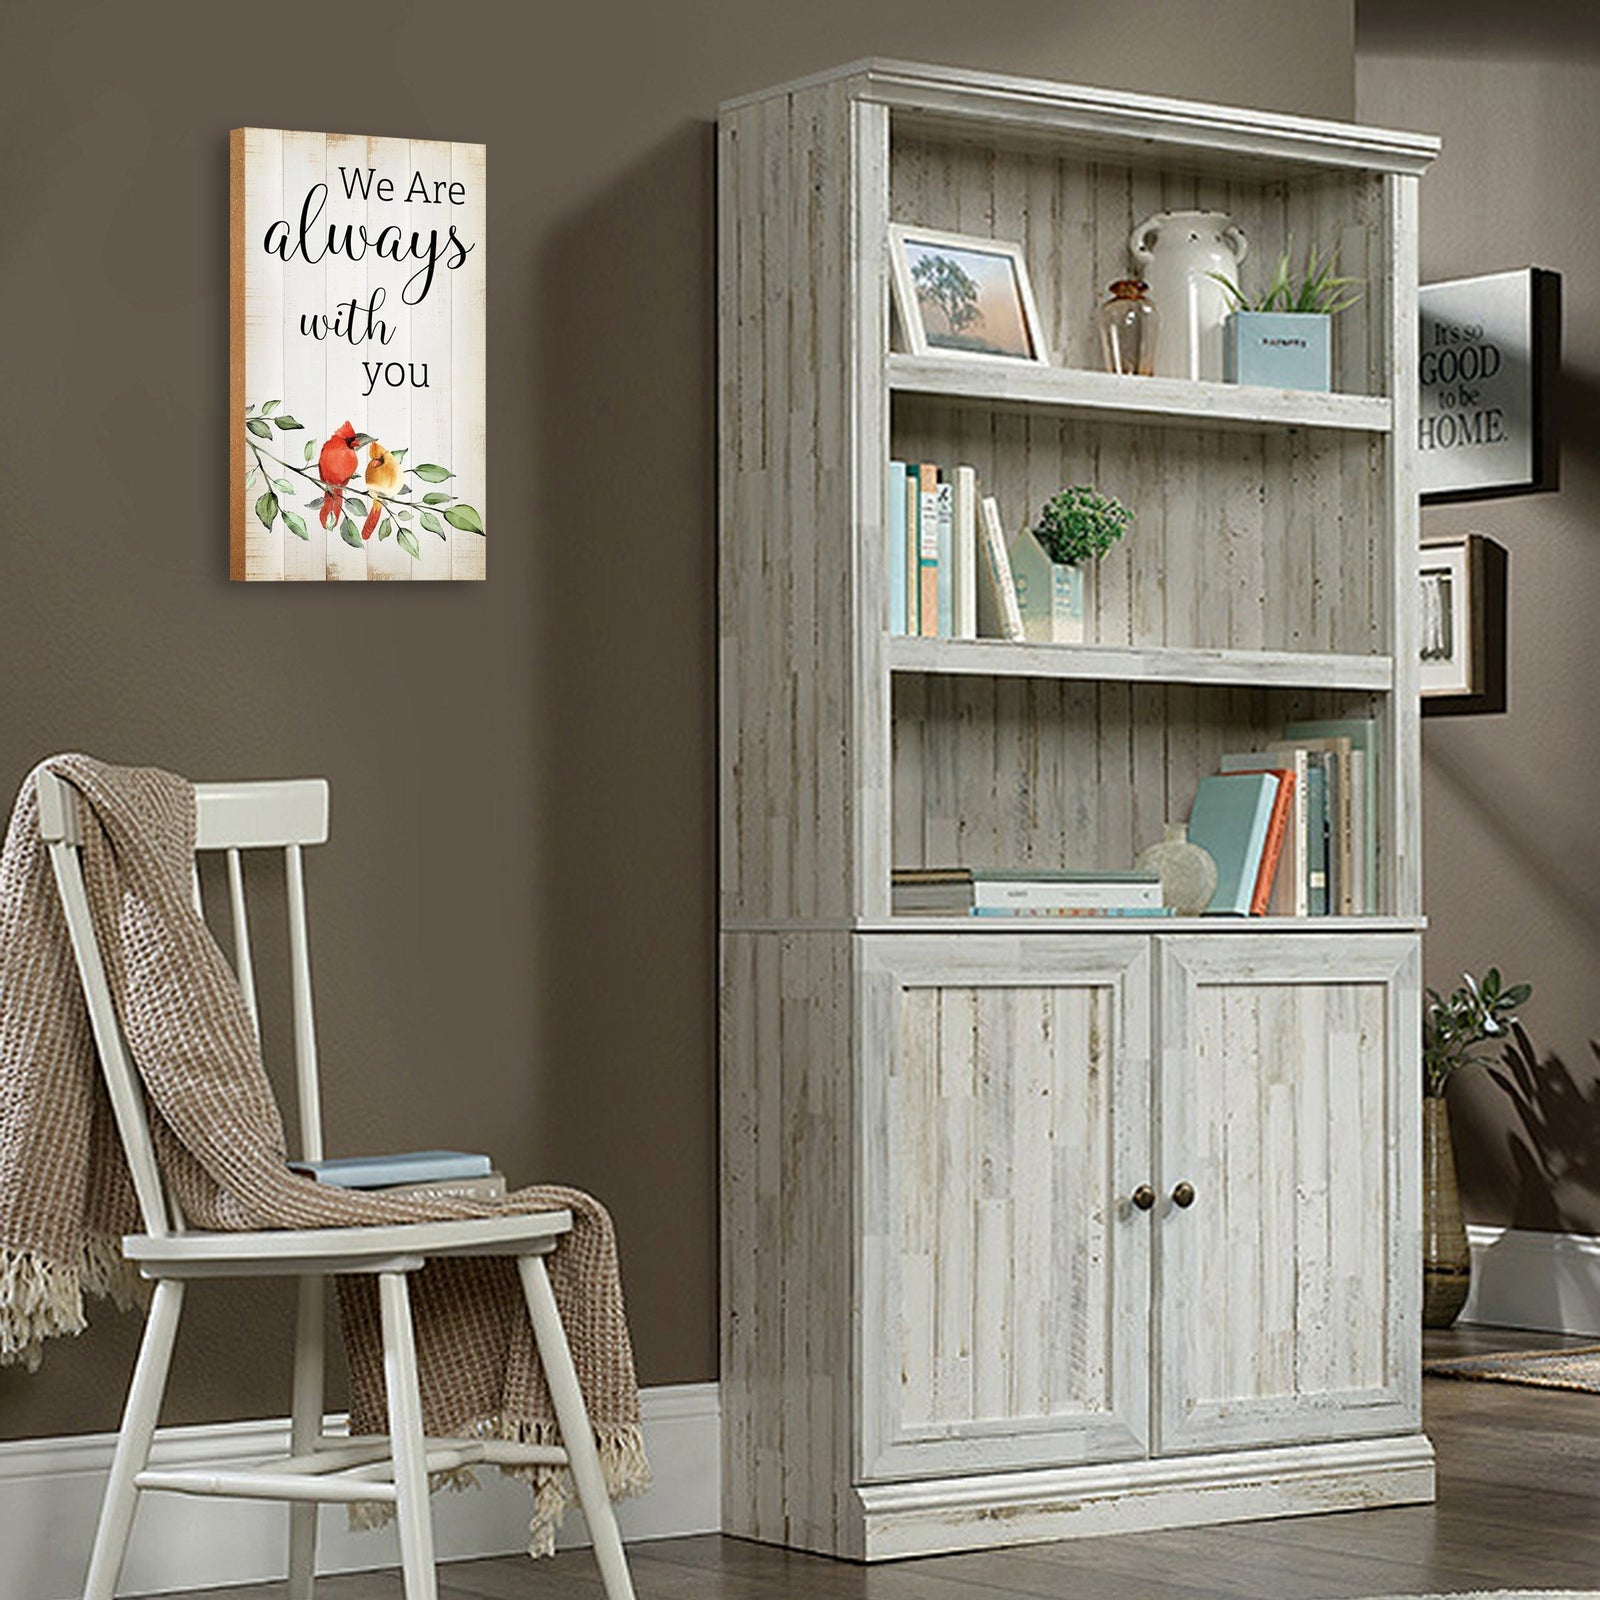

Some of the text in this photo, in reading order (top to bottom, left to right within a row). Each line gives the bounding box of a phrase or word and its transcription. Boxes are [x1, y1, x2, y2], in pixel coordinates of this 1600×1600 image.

[338, 166, 466, 205] We Are
[263, 183, 476, 306] always
[300, 287, 397, 346] with
[362, 361, 430, 397] you
[1419, 344, 1501, 387] GOOD
